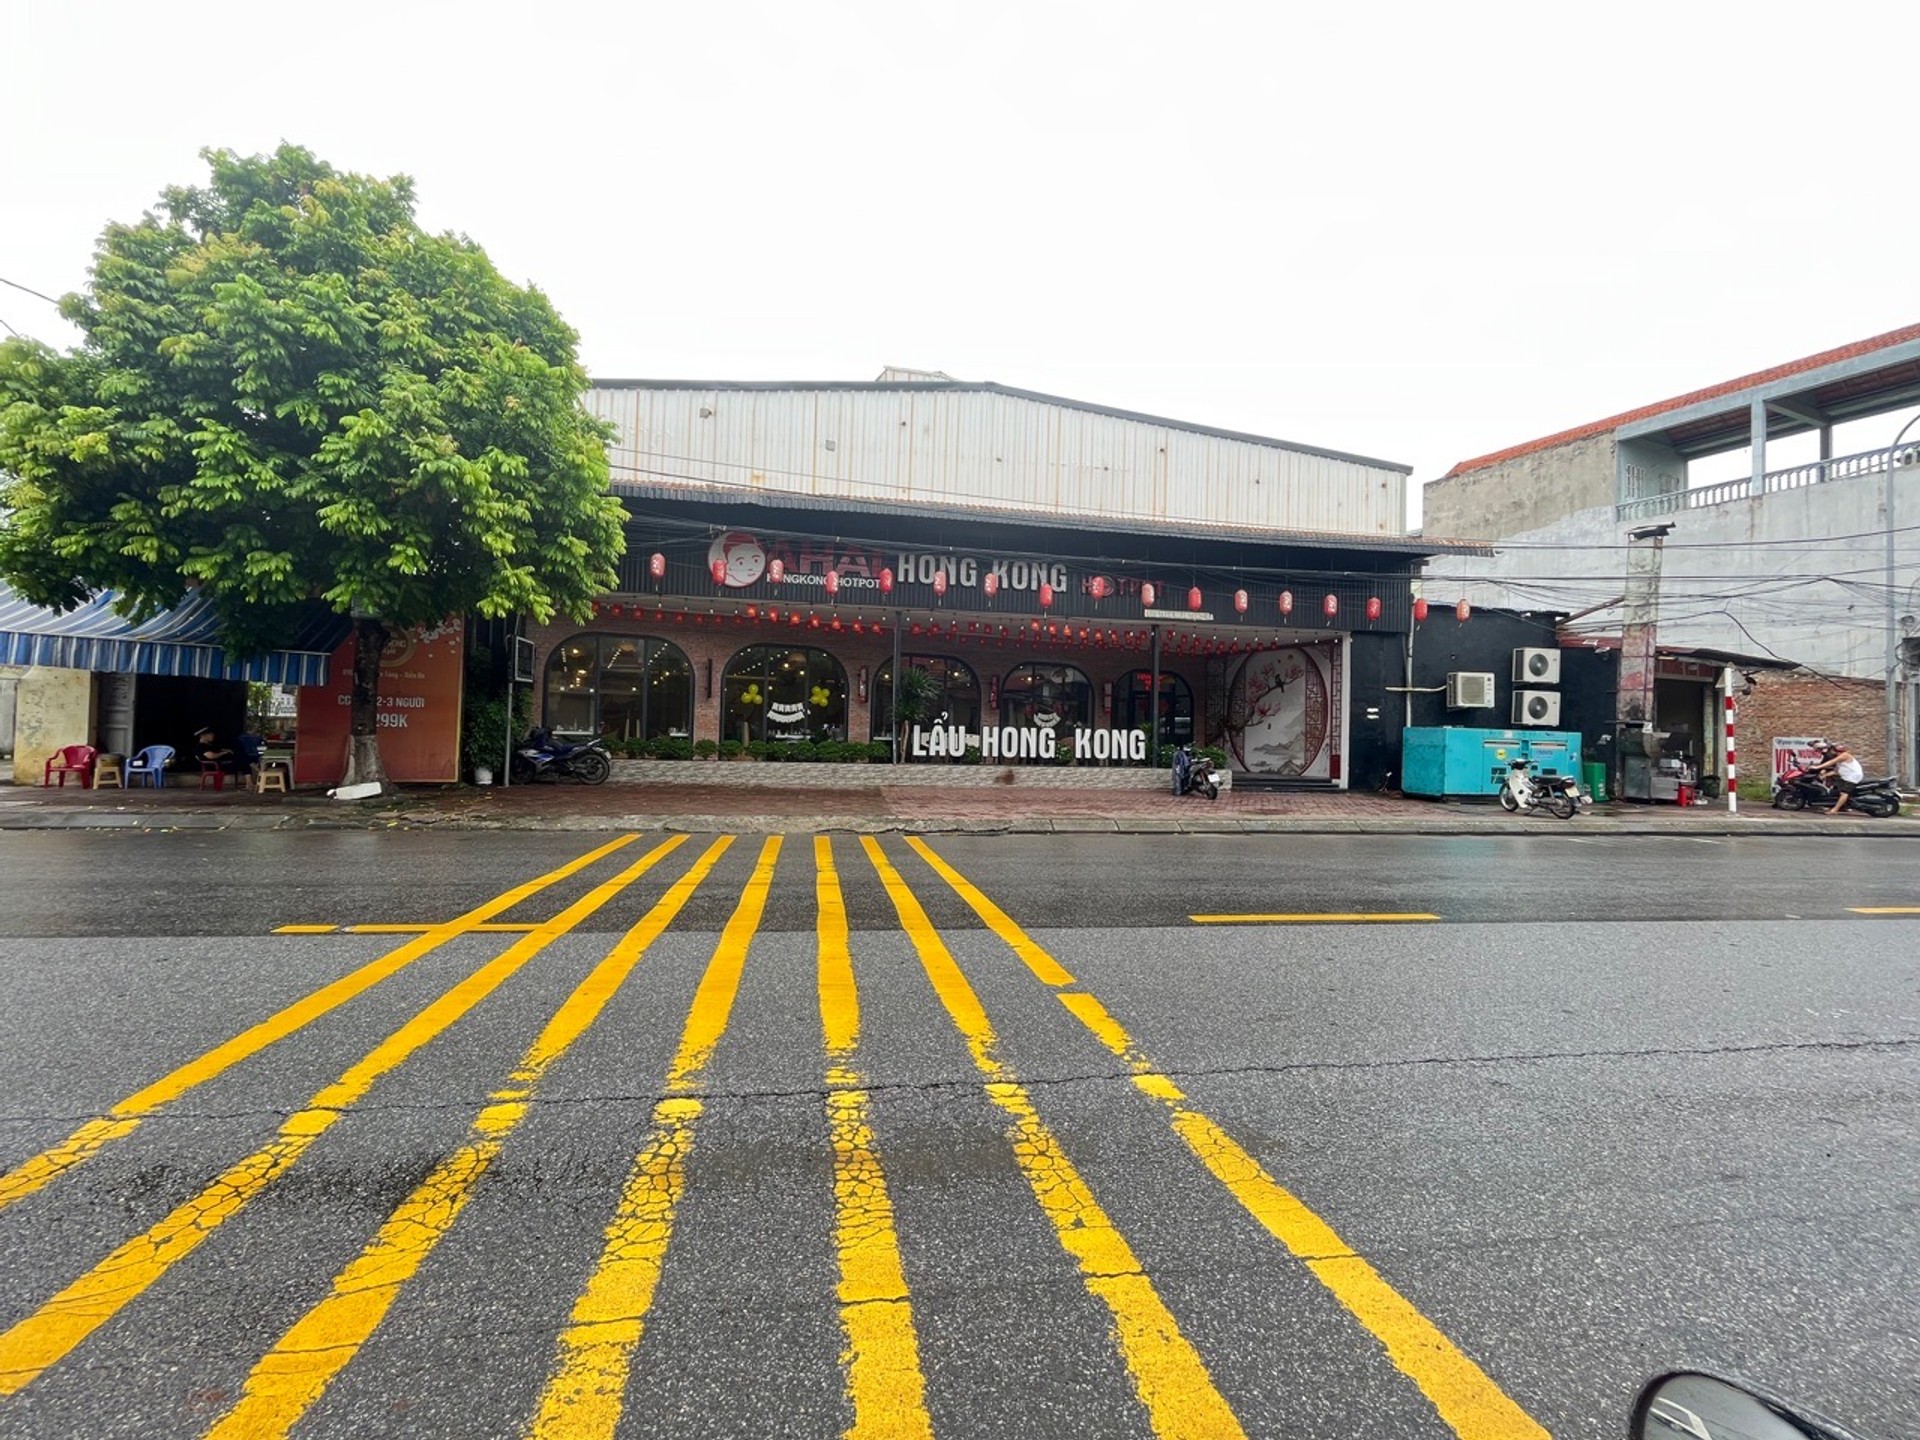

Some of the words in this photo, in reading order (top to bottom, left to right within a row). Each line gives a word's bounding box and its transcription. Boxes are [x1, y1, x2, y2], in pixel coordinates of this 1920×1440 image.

[766, 573, 829, 585] NGKON
[897, 553, 977, 587] HONG
[992, 559, 1068, 593] KONG
[1081, 575, 1165, 597] HOTPT
[376, 696, 393, 707] 2-3
[912, 711, 966, 757] LẨU
[982, 726, 1056, 759] HONG
[1075, 727, 1146, 760] KONG
